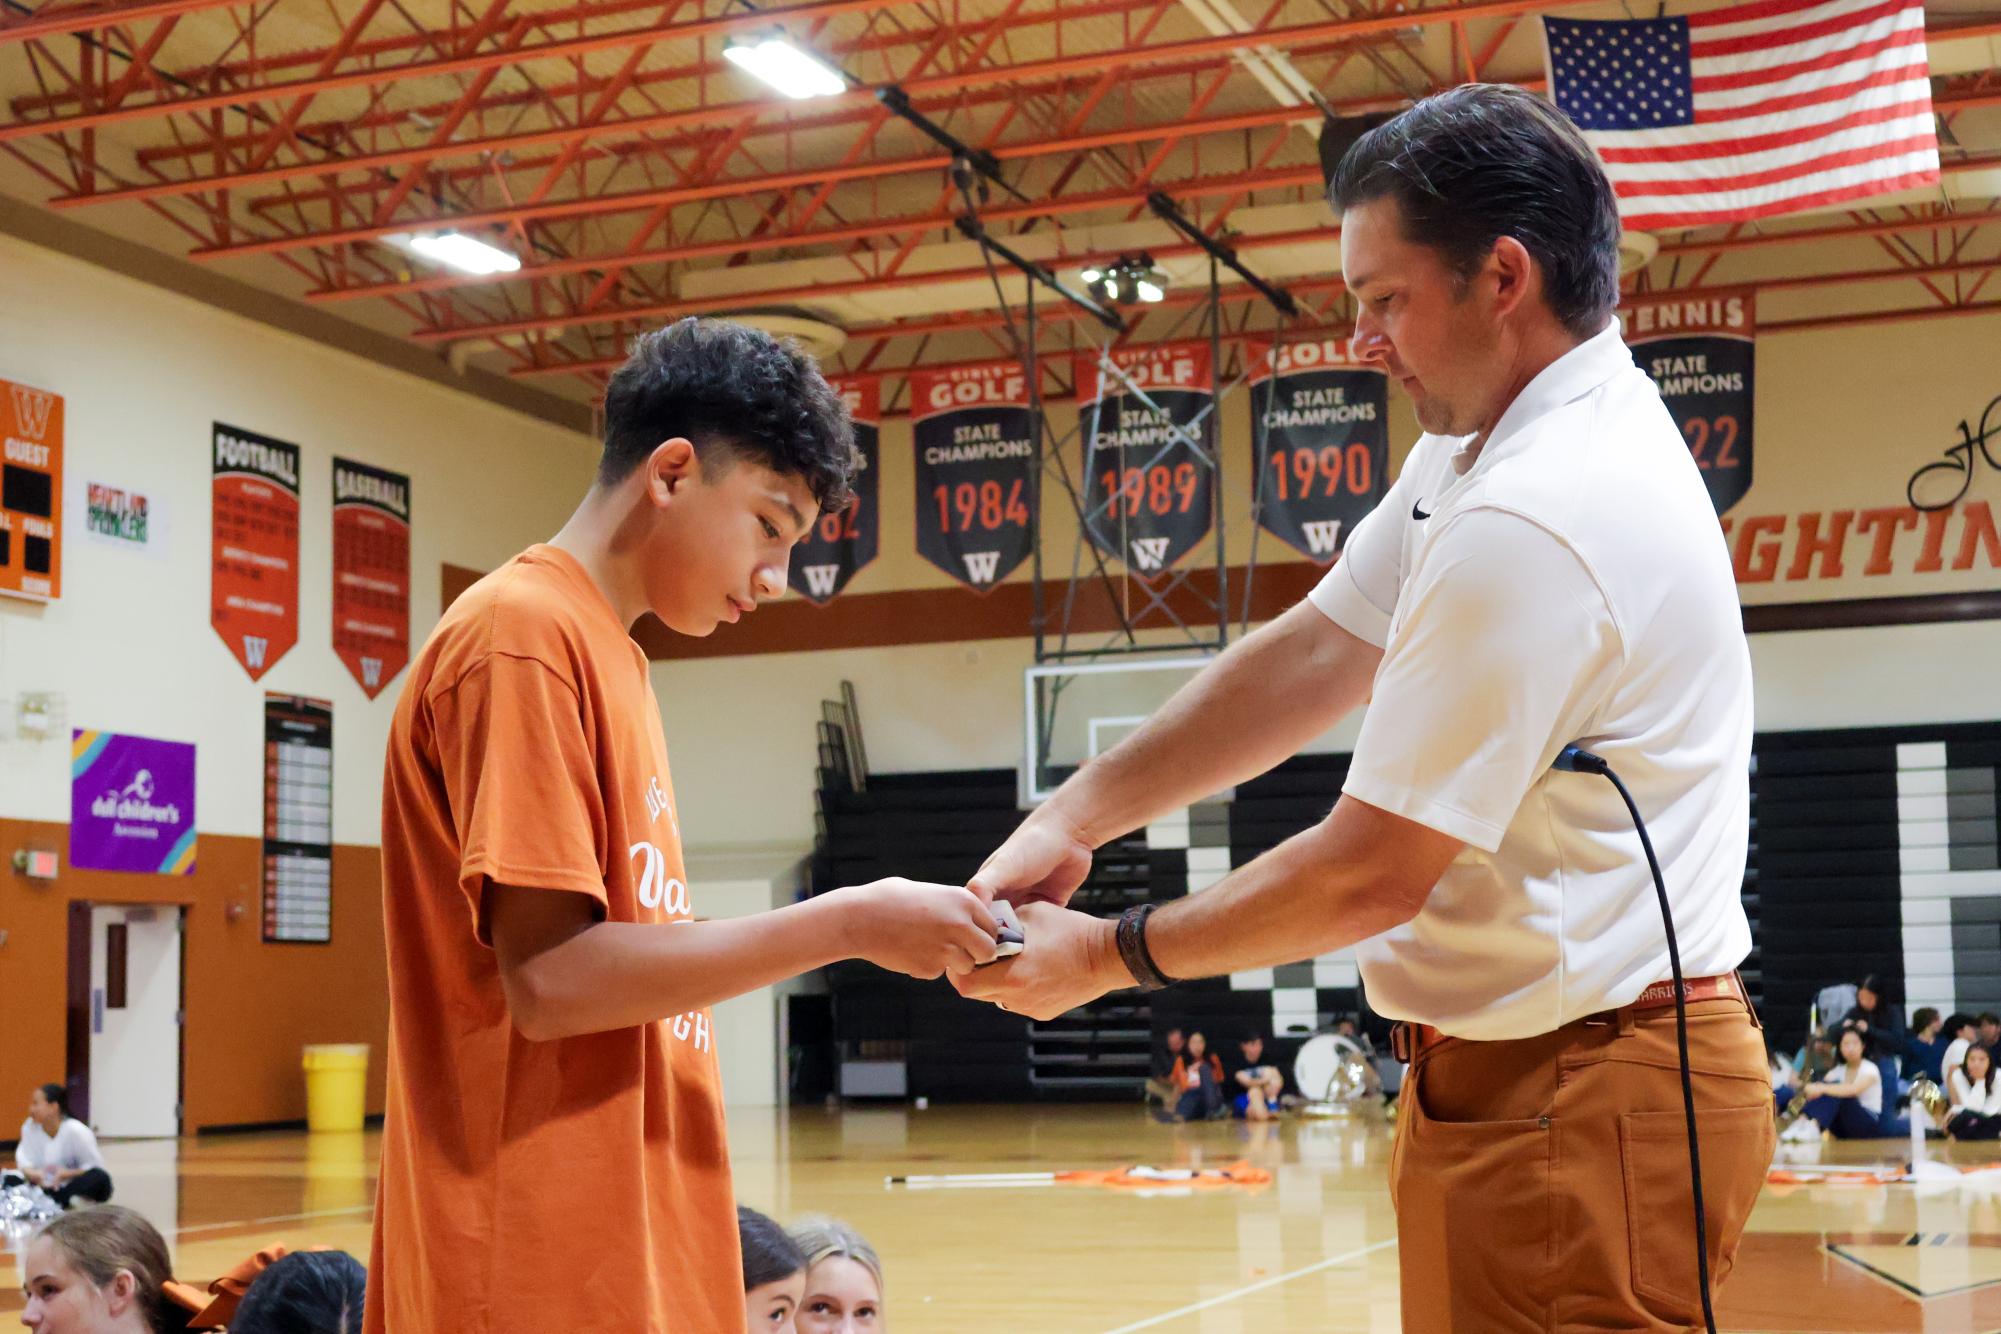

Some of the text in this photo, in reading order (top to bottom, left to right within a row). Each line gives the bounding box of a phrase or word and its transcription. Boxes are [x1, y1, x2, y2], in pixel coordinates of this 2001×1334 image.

[1617, 298, 1745, 336] TENNIS
[1652, 355, 1707, 377] STATE
[929, 376, 1026, 409] GOLF
[1293, 387, 1345, 408] STATE
[1120, 407, 1171, 428] STATE
[1262, 402, 1377, 428] CHAMPIONS
[953, 424, 1001, 444] STATE
[4, 437, 50, 468] GUEST
[216, 433, 298, 486] FOOTBALL
[925, 439, 1033, 465] CHAMPIONS
[1270, 442, 1371, 502] 1990
[336, 467, 408, 514] BASEBALL
[934, 479, 1029, 534] 1984
[1101, 463, 1197, 519] 1989
[1302, 520, 1341, 554] W
[802, 564, 841, 597] W
[962, 550, 1001, 584] W
[242, 635, 268, 669] W
[360, 657, 383, 687] W
